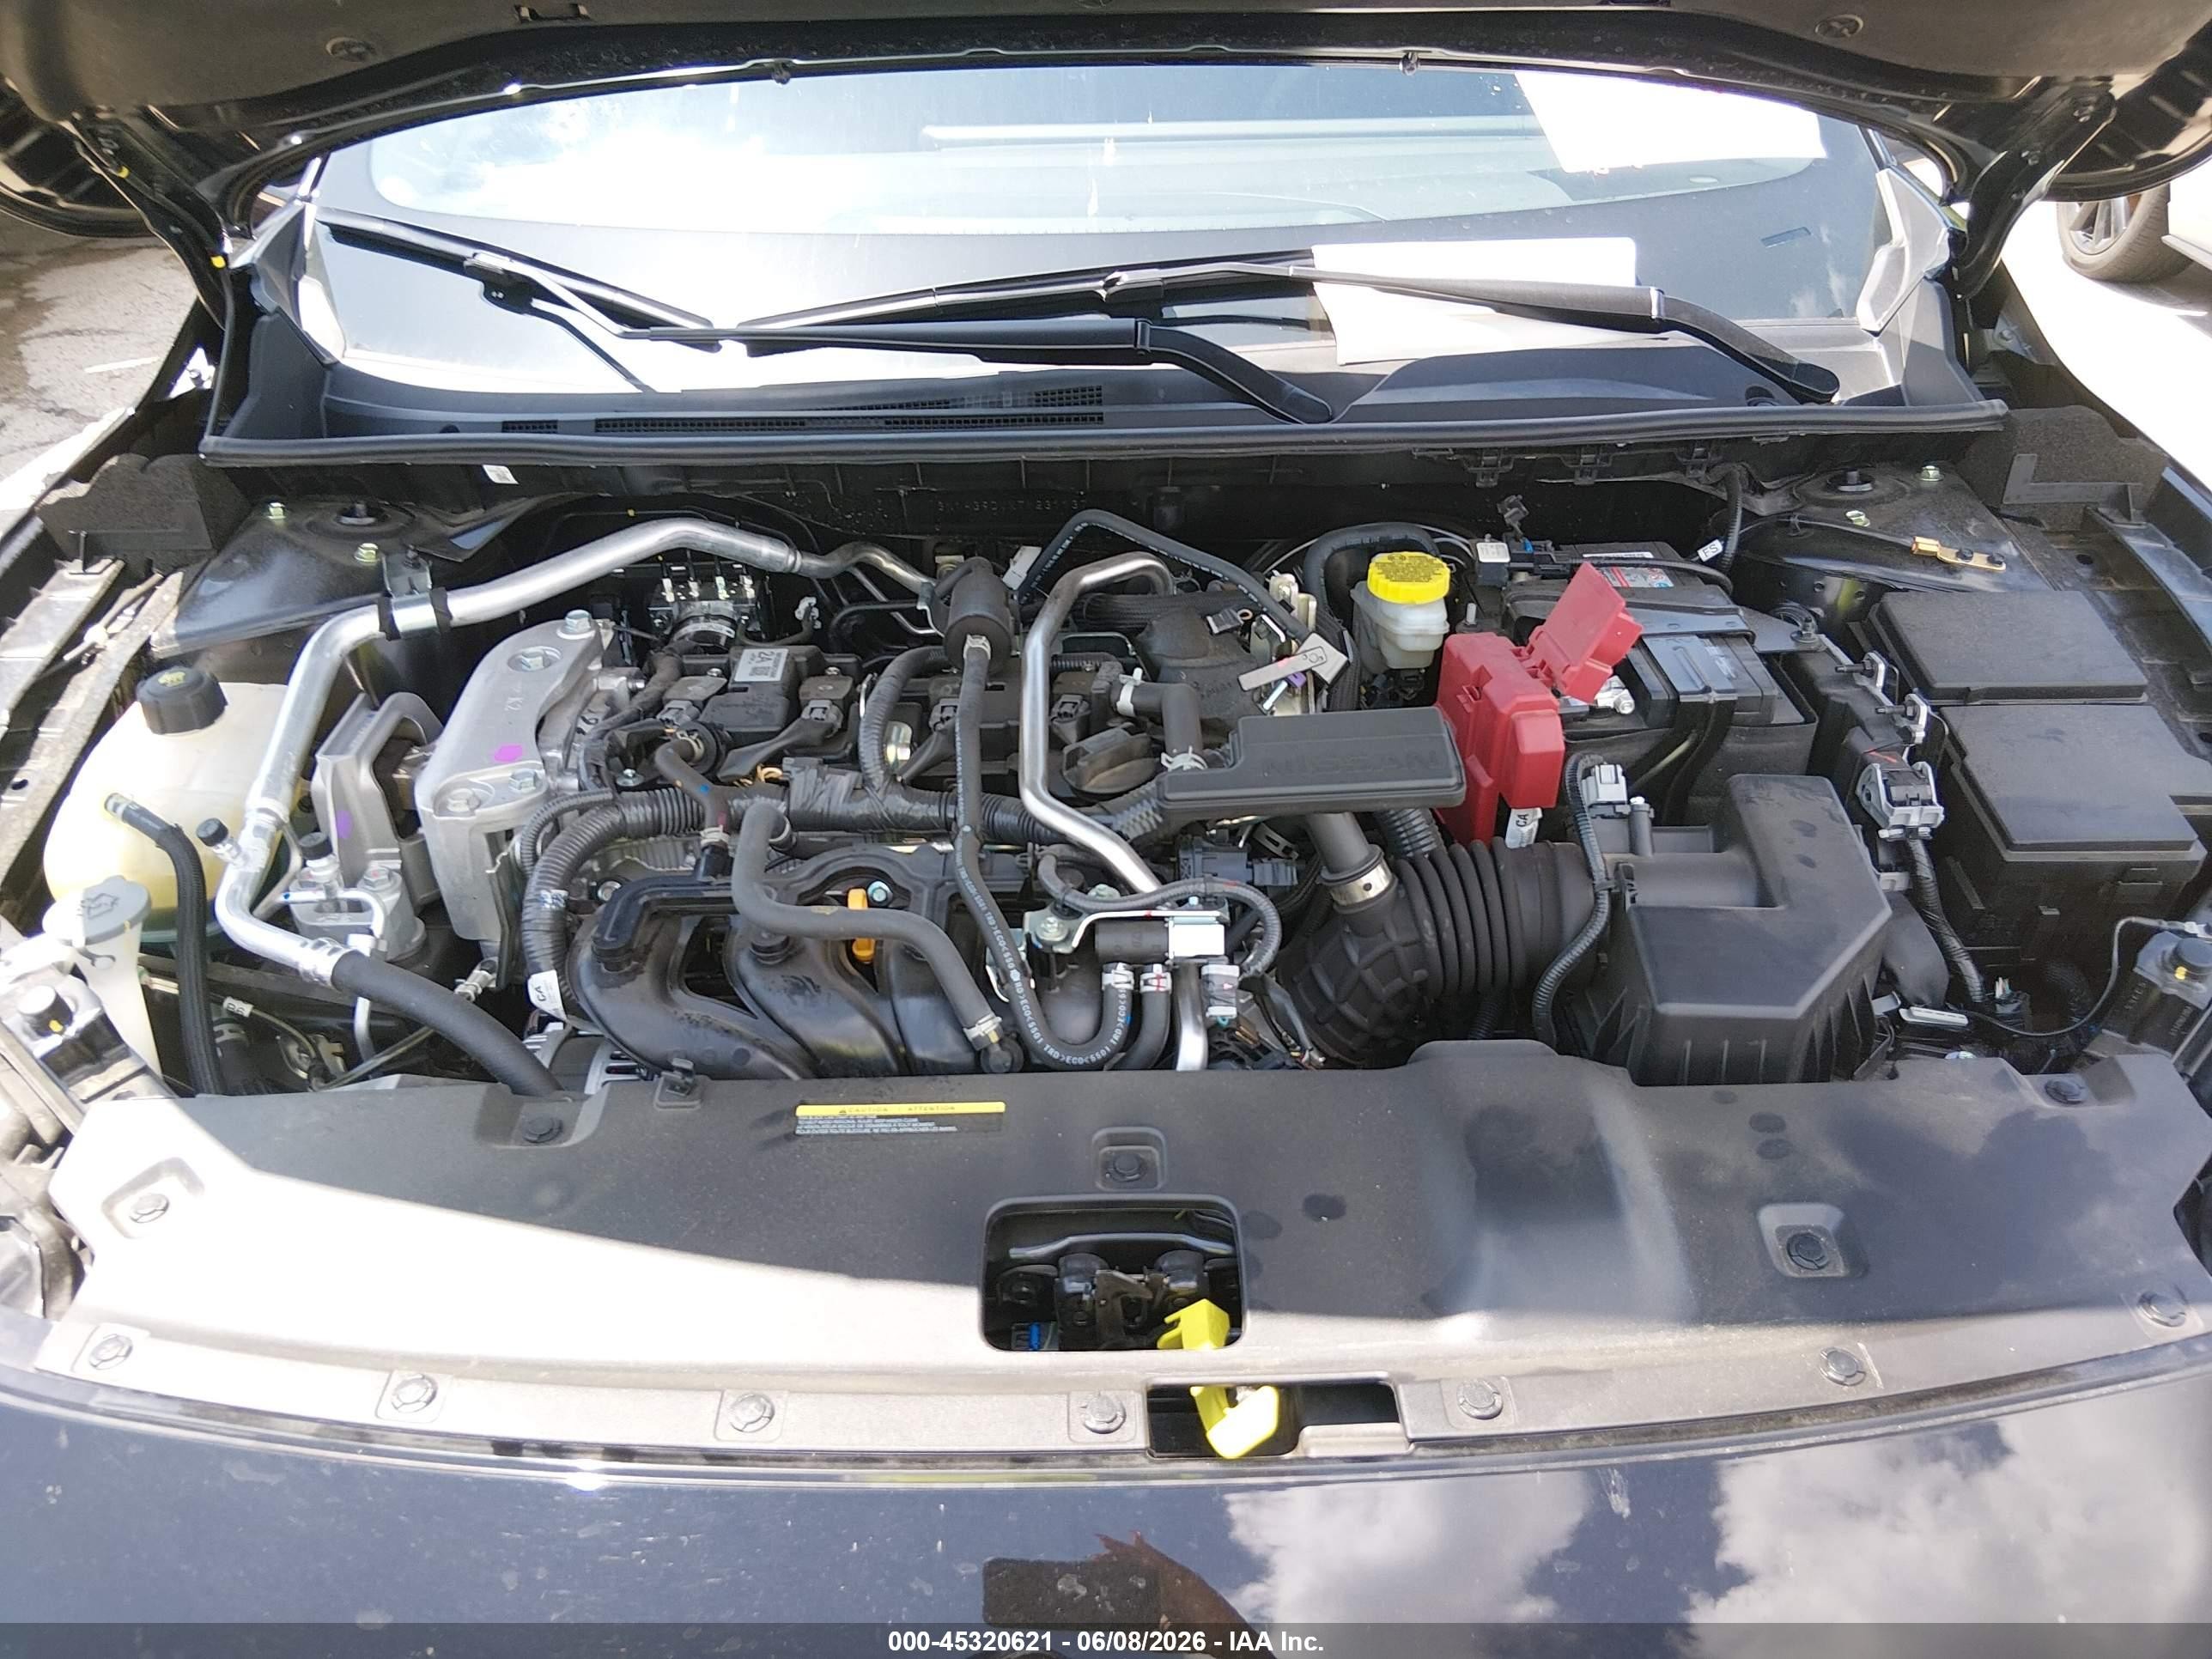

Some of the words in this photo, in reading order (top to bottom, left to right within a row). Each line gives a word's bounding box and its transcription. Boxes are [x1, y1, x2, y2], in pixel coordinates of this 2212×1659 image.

[1702, 544, 1718, 557] FS
[757, 651, 774, 663] 2A
[1262, 750, 1443, 774] NISSAN
[1515, 813, 1529, 827] CA
